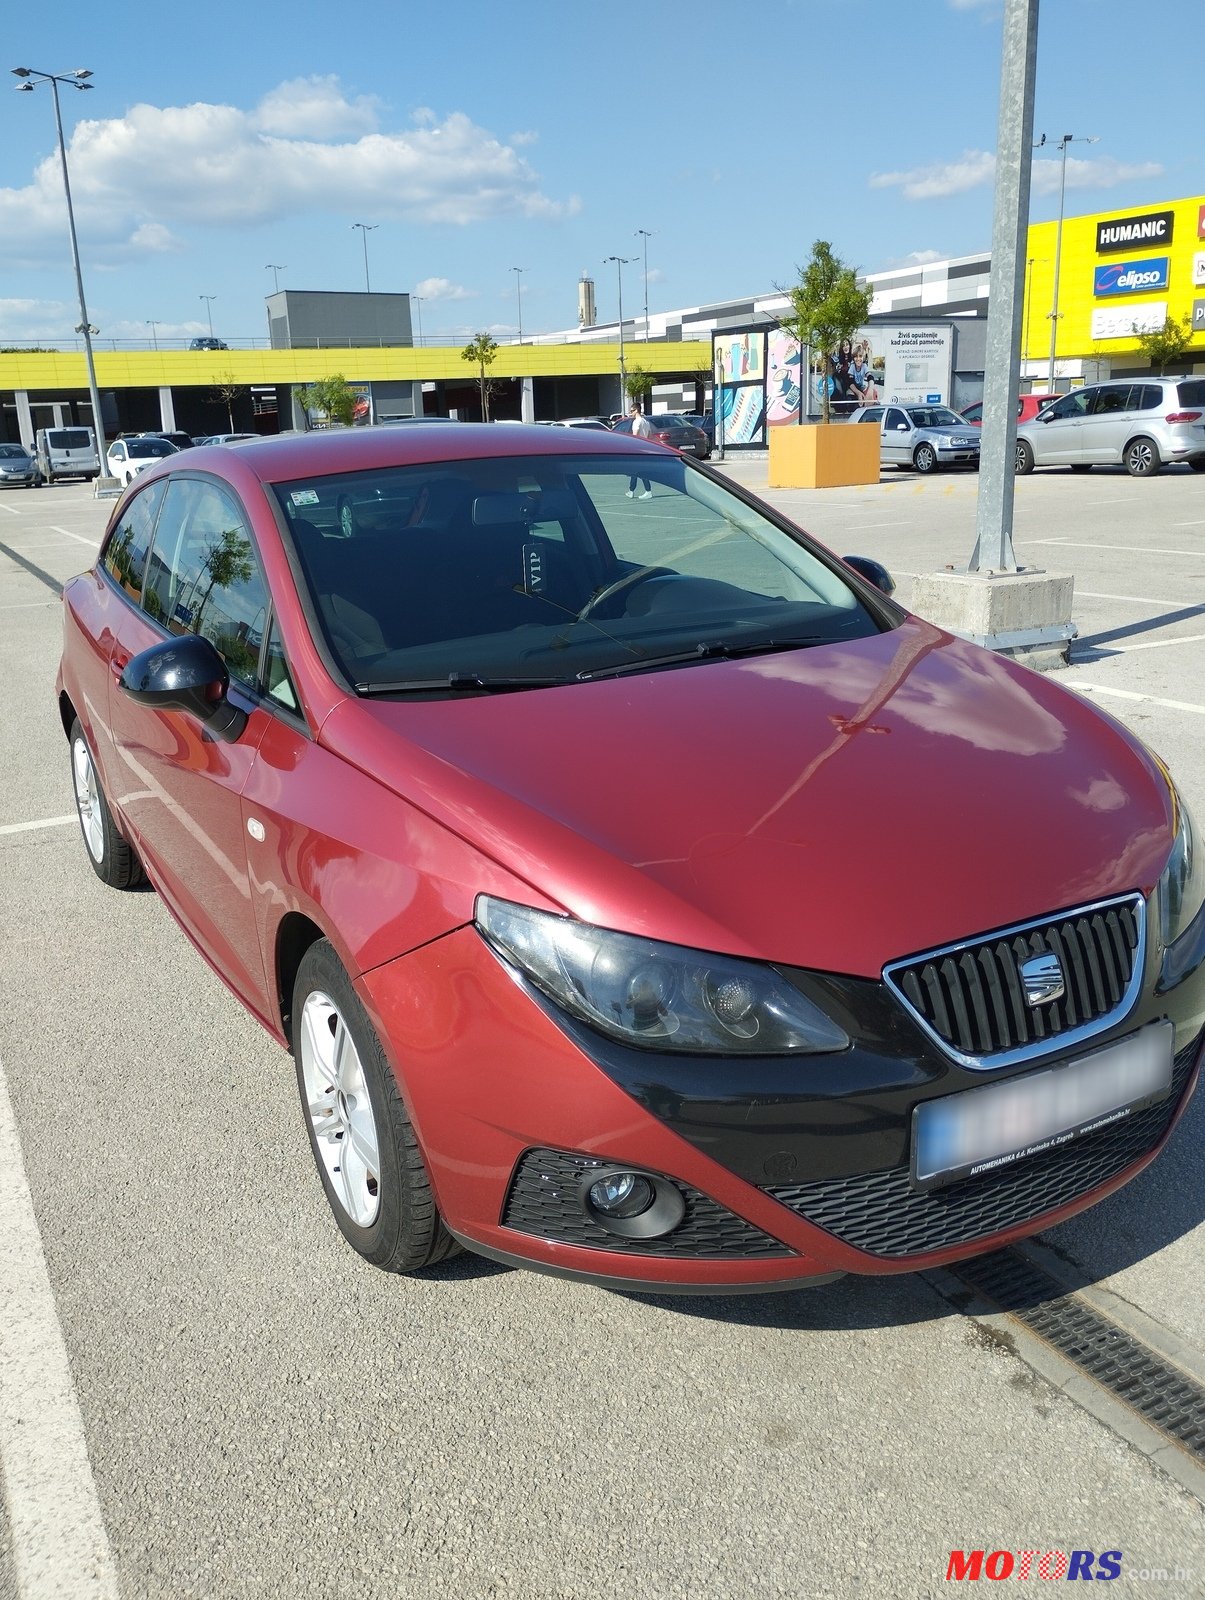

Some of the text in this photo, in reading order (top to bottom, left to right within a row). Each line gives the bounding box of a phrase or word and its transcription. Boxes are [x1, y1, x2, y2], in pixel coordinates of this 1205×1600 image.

[1100, 219, 1166, 244] HUMANIC
[1117, 269, 1160, 289] elipso
[911, 332, 938, 340] opuštenije
[530, 552, 542, 586] VIP
[970, 1154, 1015, 1175] AUTOMEHANIKA
[1016, 1150, 1026, 1159] d.d.
[1056, 1132, 1074, 1144] Zagreb
[1080, 1108, 1130, 1134] www.automehanika.hr
